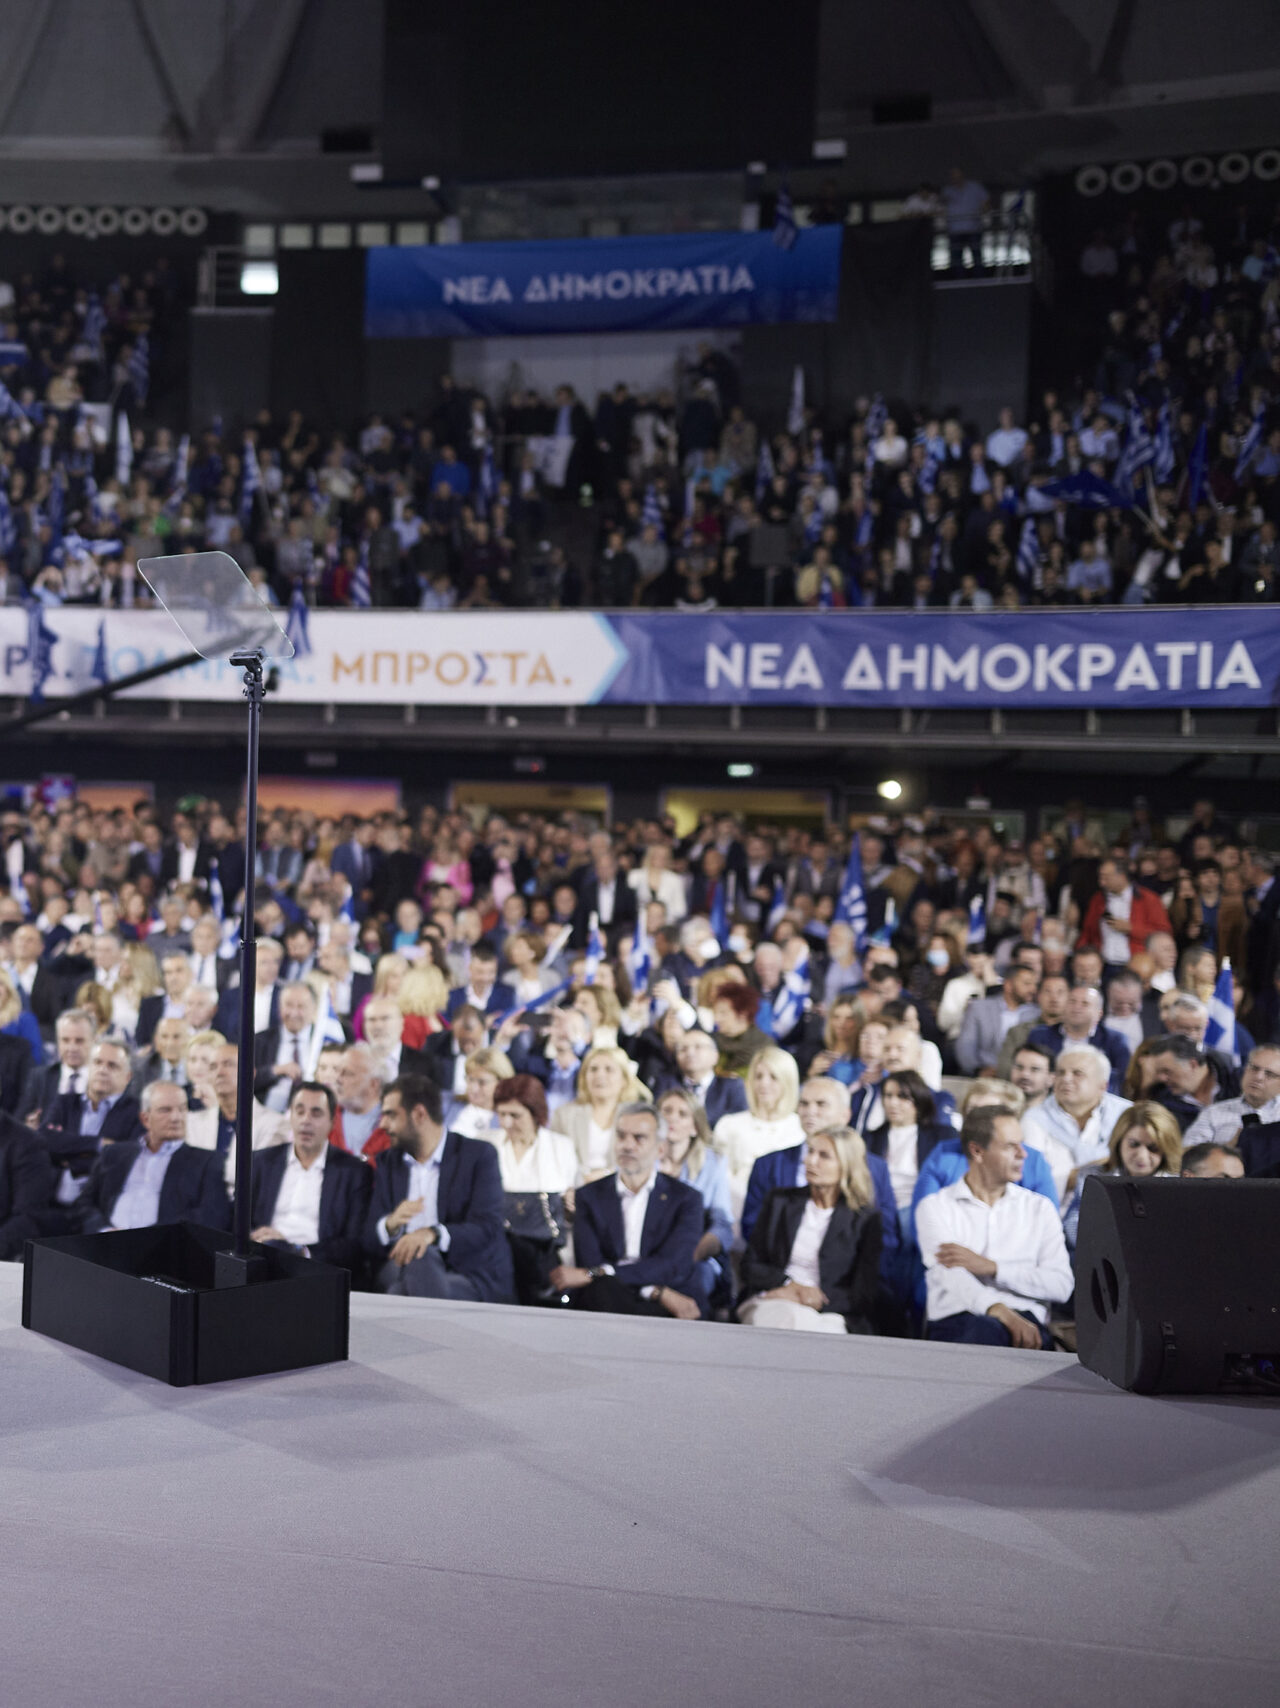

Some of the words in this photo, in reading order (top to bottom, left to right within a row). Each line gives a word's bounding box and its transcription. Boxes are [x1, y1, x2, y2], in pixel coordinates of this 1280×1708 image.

[443, 277, 513, 304] ΝΕΑ
[523, 264, 755, 301] ΔΗΜΟΚΡΑΤΙΑ
[331, 651, 573, 685] ΜΠΡΟΣΤΑ.
[704, 642, 821, 690] ΝΕΑ
[843, 640, 1262, 692] ΔΗΜΟΚΡΑΤΙΑ
